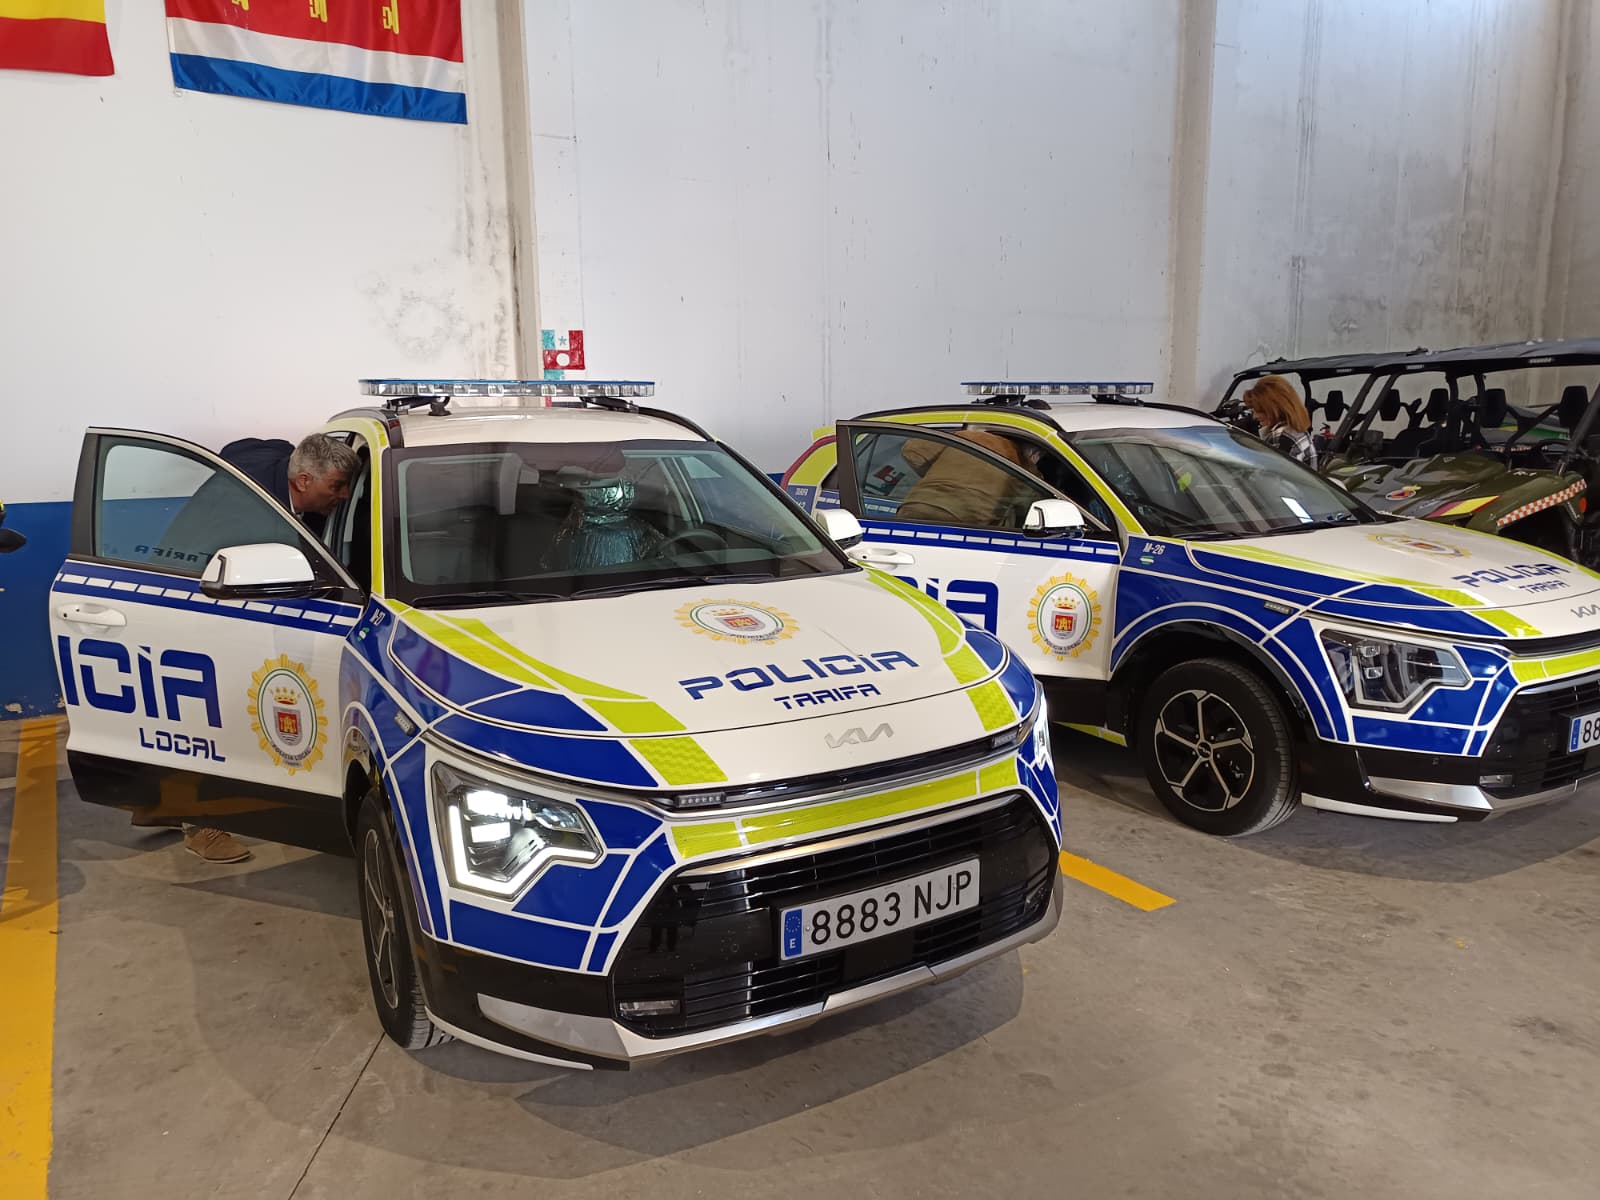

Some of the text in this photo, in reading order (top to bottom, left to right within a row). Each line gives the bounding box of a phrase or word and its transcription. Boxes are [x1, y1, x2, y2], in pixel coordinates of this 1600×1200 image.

[773, 682, 882, 710] TARIFA
[139, 727, 226, 763] LOCAL
[824, 722, 894, 749] KIA
[811, 870, 972, 945] 8883 NJP
[789, 938, 797, 949] E
